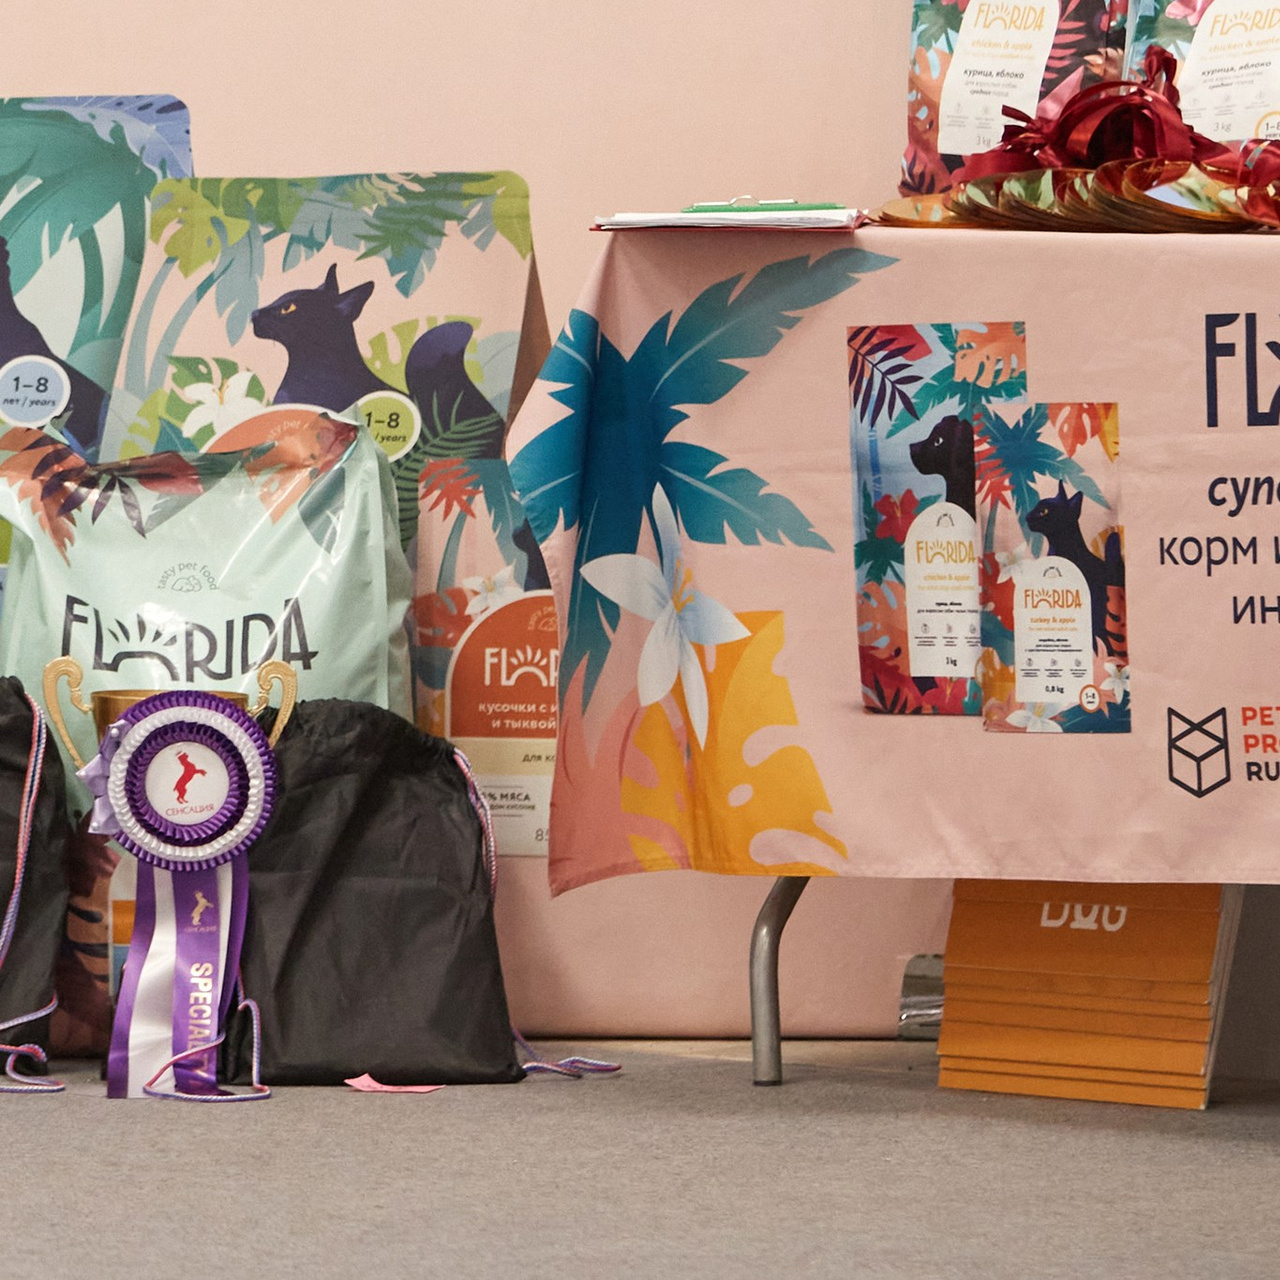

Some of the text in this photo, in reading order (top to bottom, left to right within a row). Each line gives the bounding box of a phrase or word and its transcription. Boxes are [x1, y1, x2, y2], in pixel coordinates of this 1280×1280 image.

[973, 1, 1046, 32] FLORIDA
[28, 399, 56, 407] years
[379, 433, 407, 443] years
[916, 540, 976, 564] FLORIDA
[1160, 536, 1257, 577] корм
[1024, 588, 1082, 609] FLORIDA
[61, 594, 319, 683] FLORIDA
[478, 703, 536, 716] кусочки
[1246, 761, 1280, 782] RU
